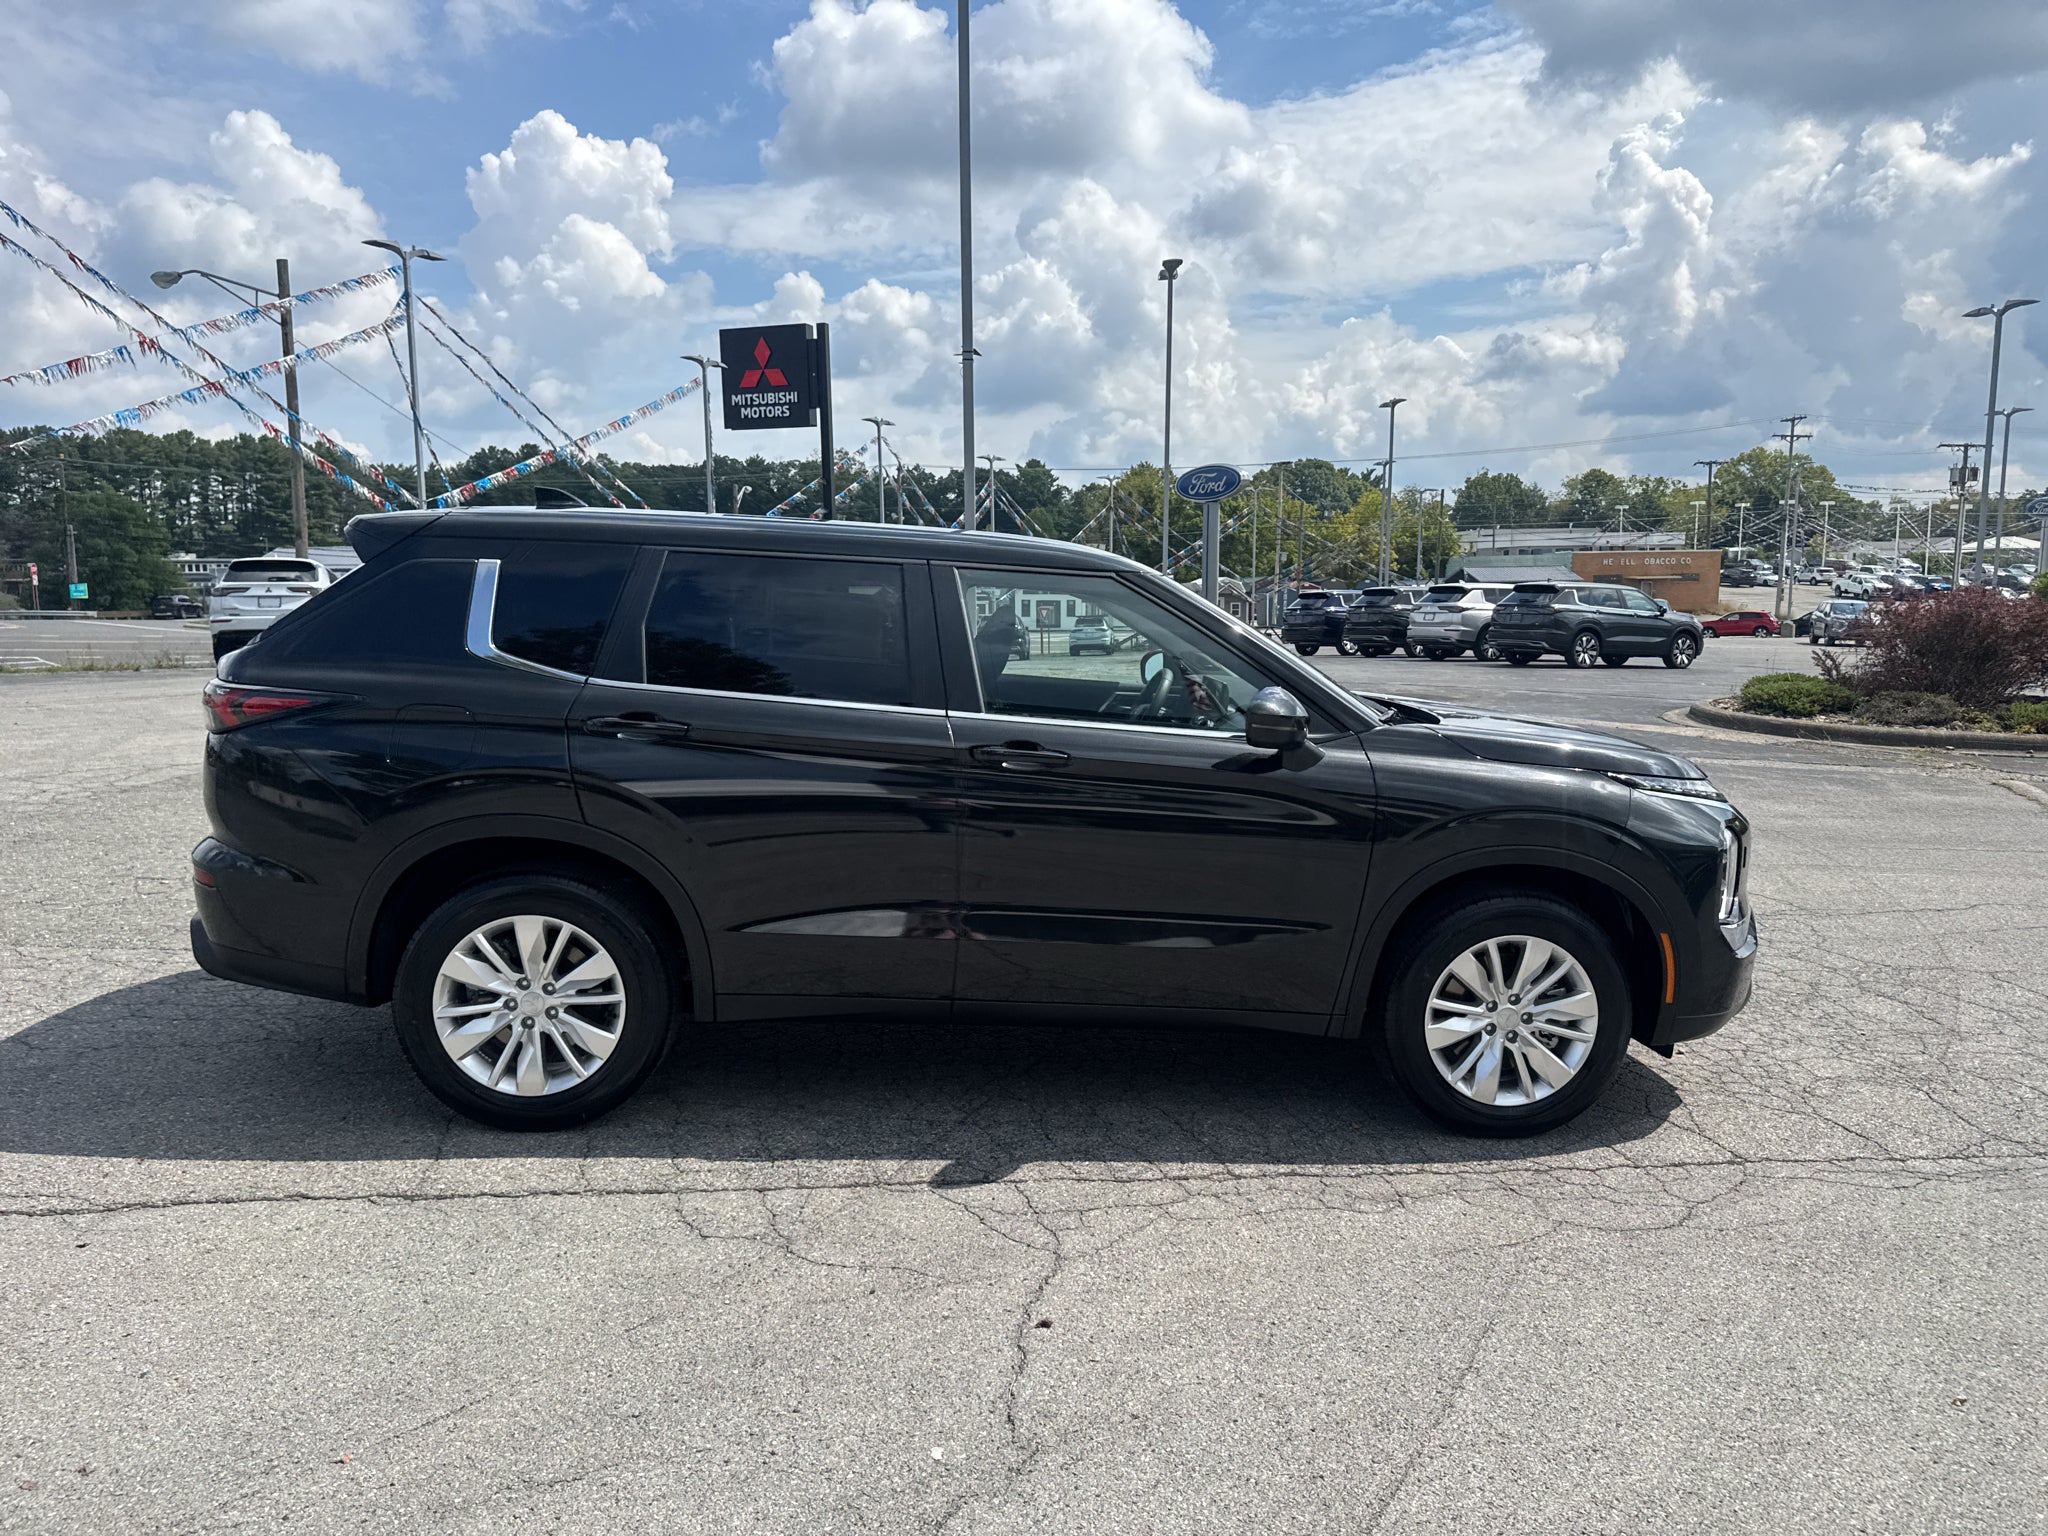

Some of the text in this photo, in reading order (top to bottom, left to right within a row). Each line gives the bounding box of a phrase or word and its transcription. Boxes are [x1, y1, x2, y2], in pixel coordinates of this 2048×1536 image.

[731, 391, 798, 405] MITSUBISHI
[740, 405, 790, 418] MOTORS
[1188, 472, 1227, 494] Ford
